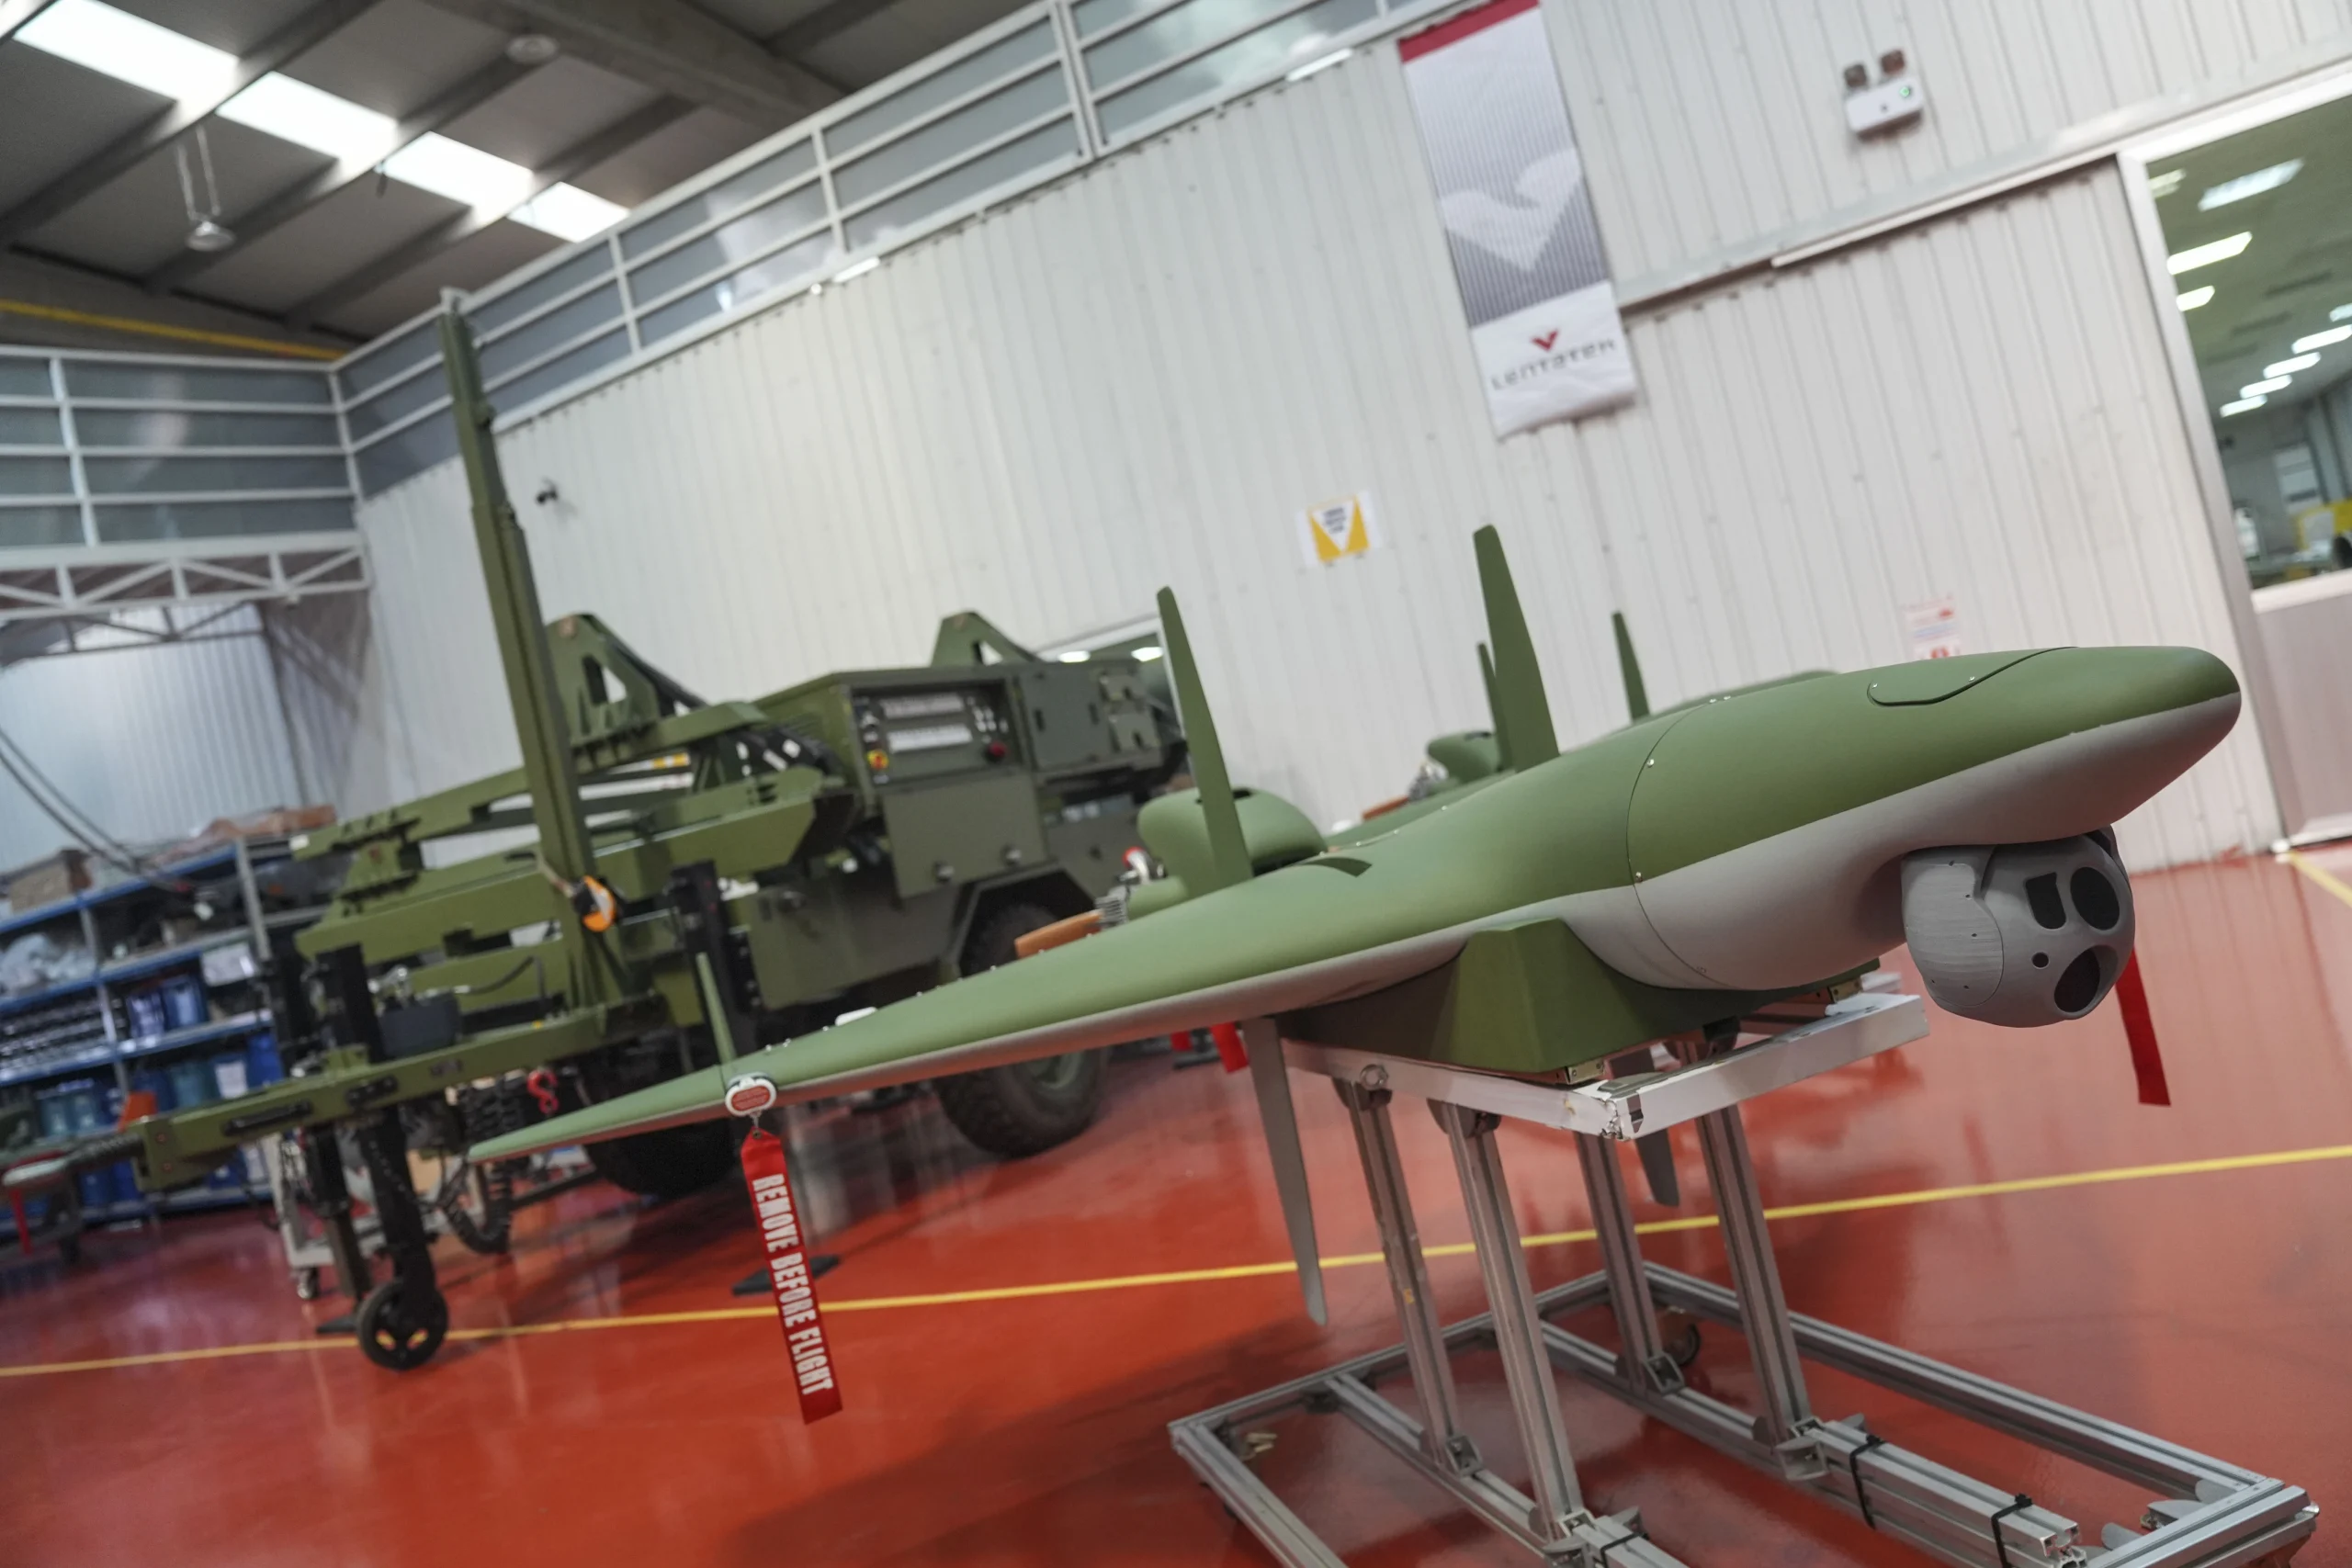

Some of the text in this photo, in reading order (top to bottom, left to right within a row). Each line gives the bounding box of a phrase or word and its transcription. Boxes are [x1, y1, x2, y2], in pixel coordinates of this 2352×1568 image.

[752, 1173, 834, 1395] REMOVE BEFORE FLIGHT
